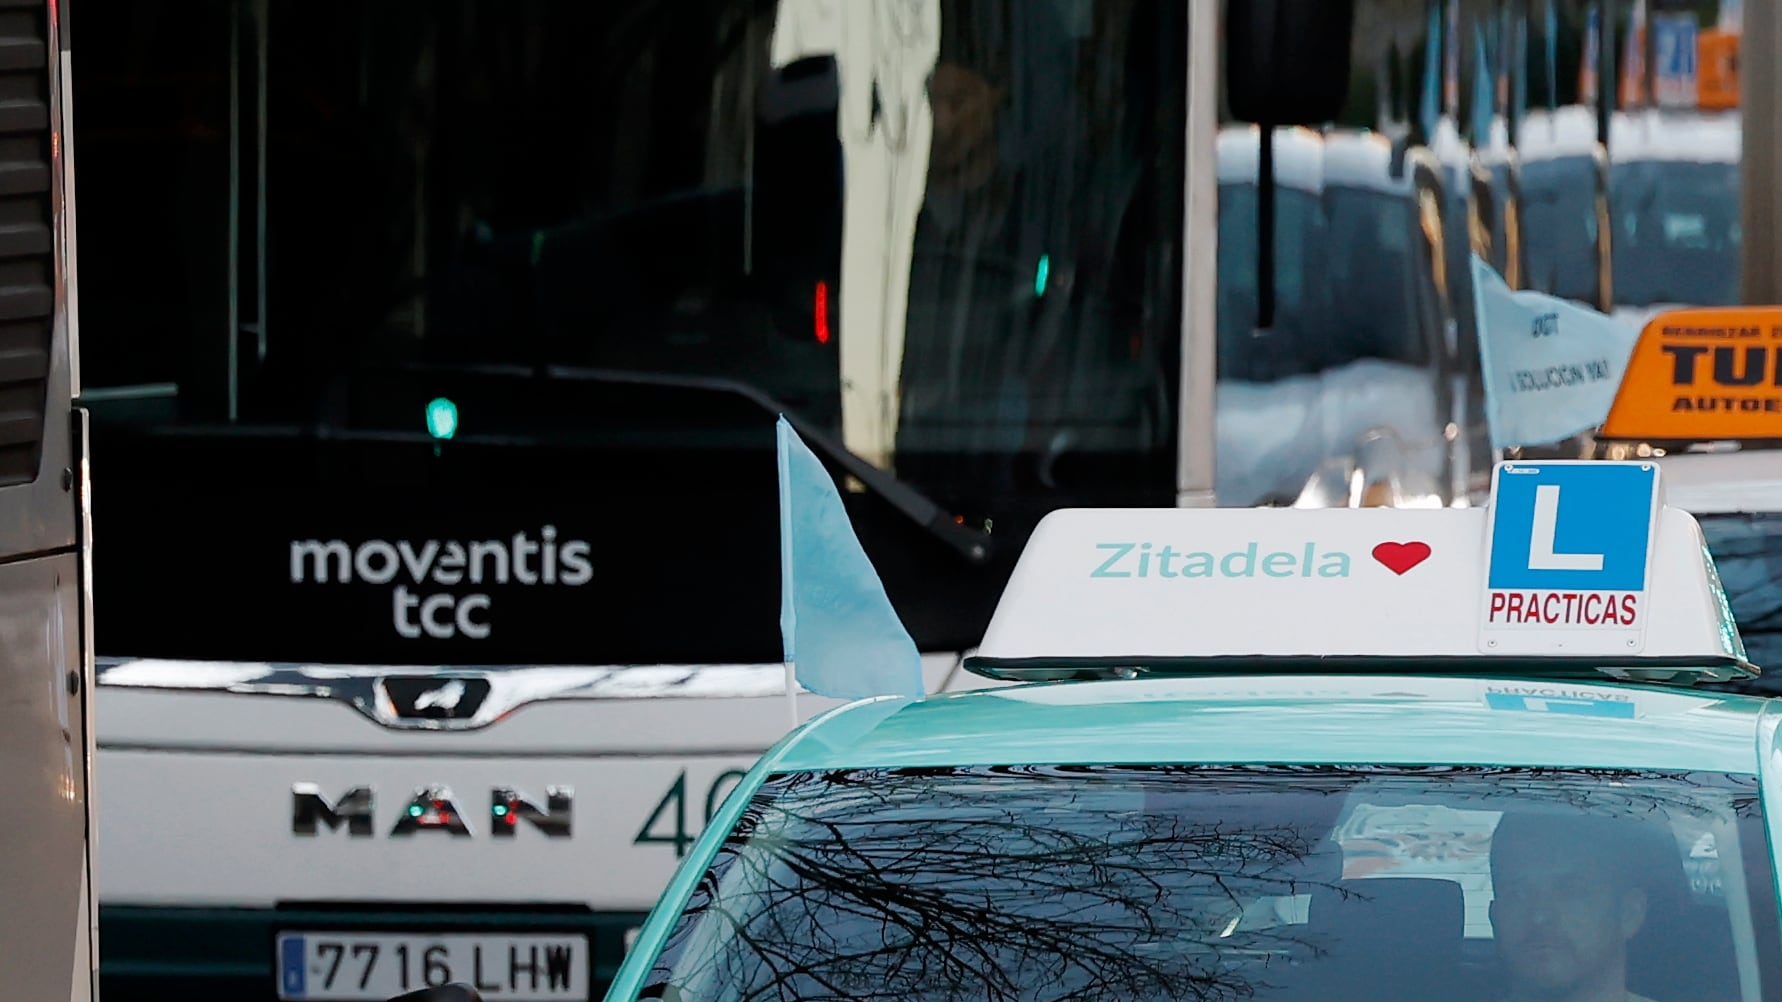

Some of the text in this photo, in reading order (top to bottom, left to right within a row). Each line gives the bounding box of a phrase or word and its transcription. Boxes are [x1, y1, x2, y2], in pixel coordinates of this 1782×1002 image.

[290, 524, 594, 585] moventis
[1528, 484, 1604, 570] L
[1090, 542, 1351, 578] Zitadela
[392, 584, 492, 639] tcc
[1489, 592, 1637, 625] PRACTICAS
[291, 782, 576, 837] MAN
[316, 944, 573, 992] 7716 LHW
